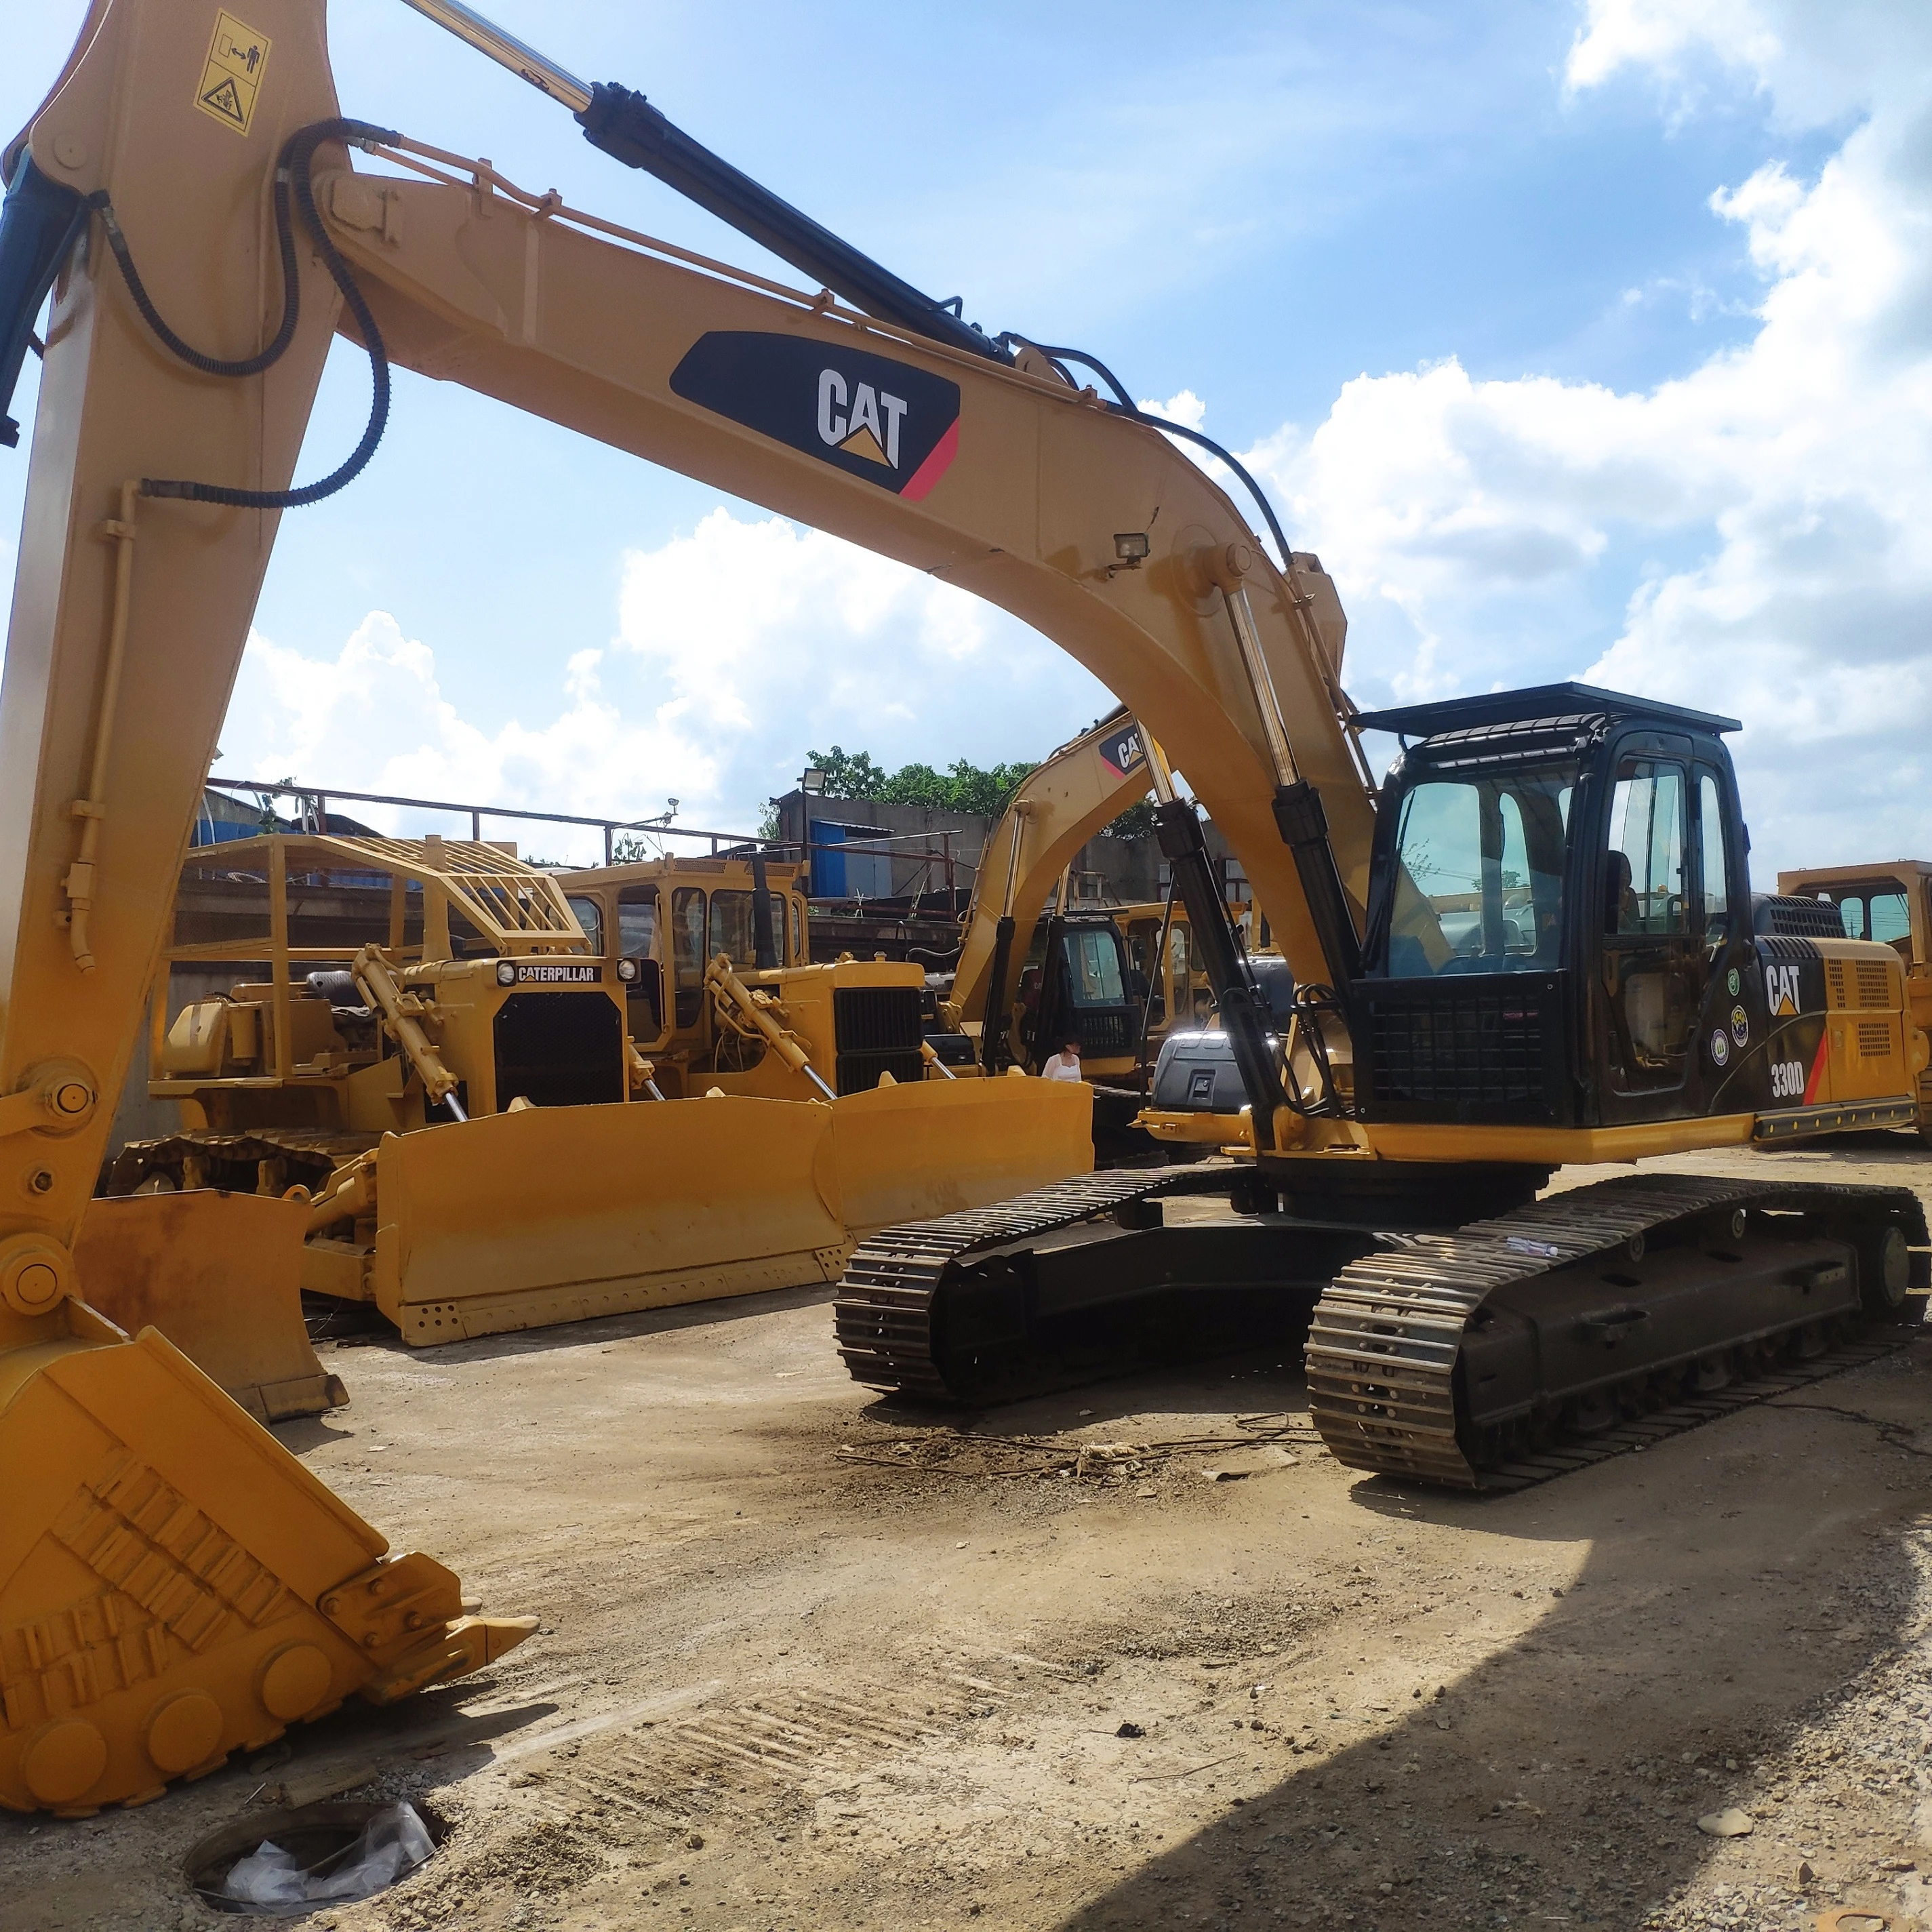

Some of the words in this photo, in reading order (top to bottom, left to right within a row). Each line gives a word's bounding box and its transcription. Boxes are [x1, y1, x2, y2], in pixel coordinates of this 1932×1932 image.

[818, 369, 907, 470] CAT
[518, 967, 594, 982] CATERPILLAR
[1766, 965, 1800, 1016] CAT
[1771, 1061, 1805, 1098] 330D
